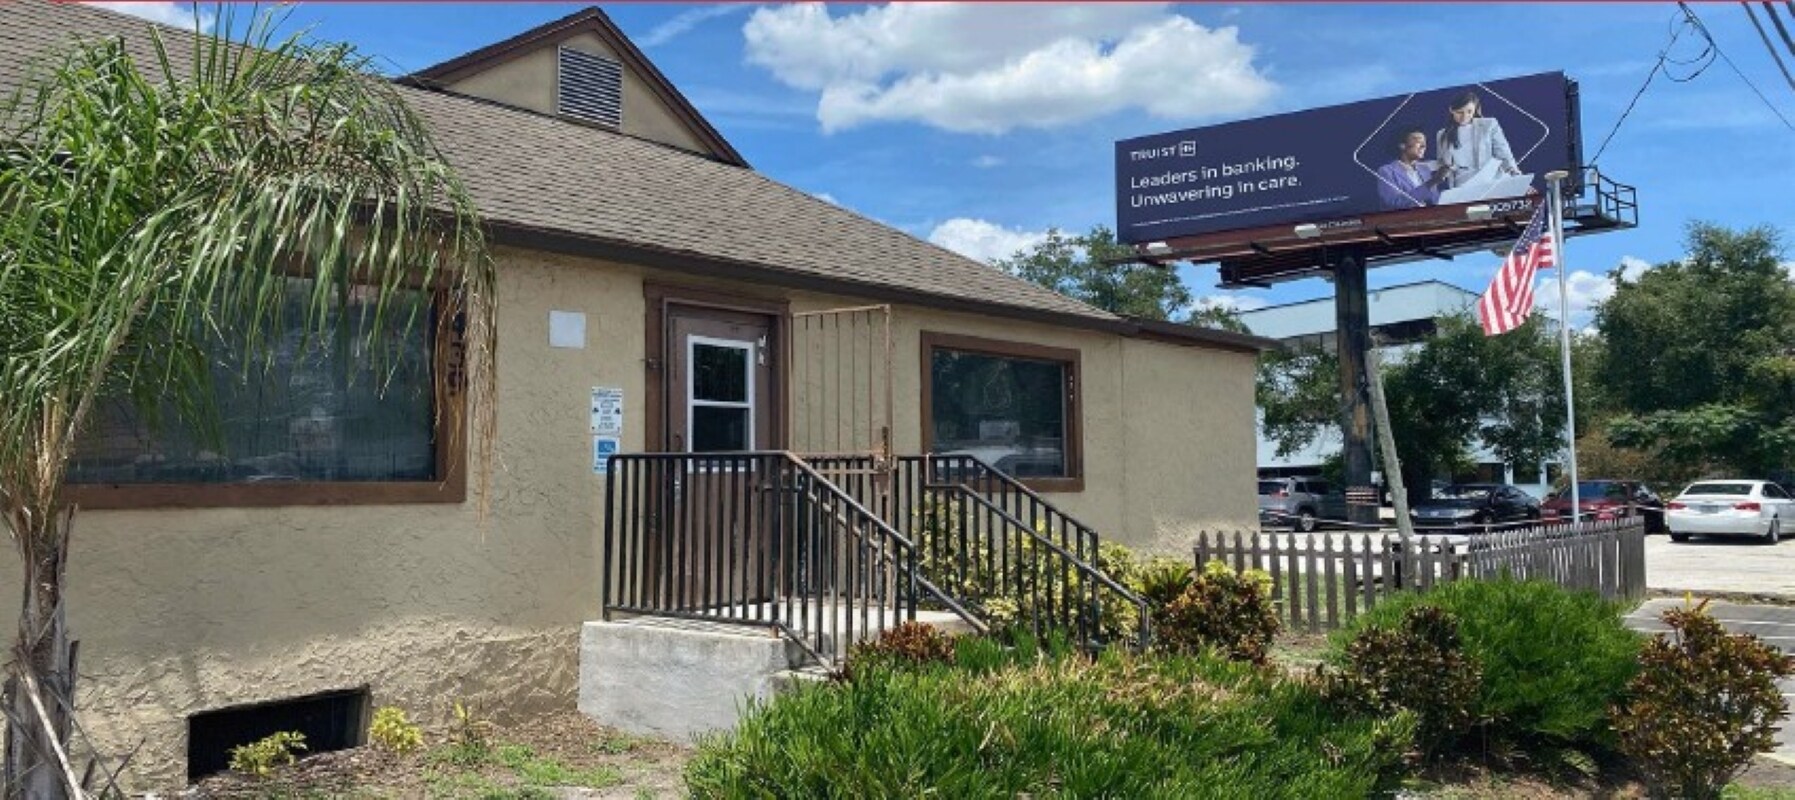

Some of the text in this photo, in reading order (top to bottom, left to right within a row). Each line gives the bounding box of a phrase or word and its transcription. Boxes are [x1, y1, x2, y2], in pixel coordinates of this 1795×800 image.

[1130, 145, 1176, 161] TRUIST
[1131, 155, 1300, 190] Leaders in banking.
[1131, 175, 1302, 208] Unwavering in care.
